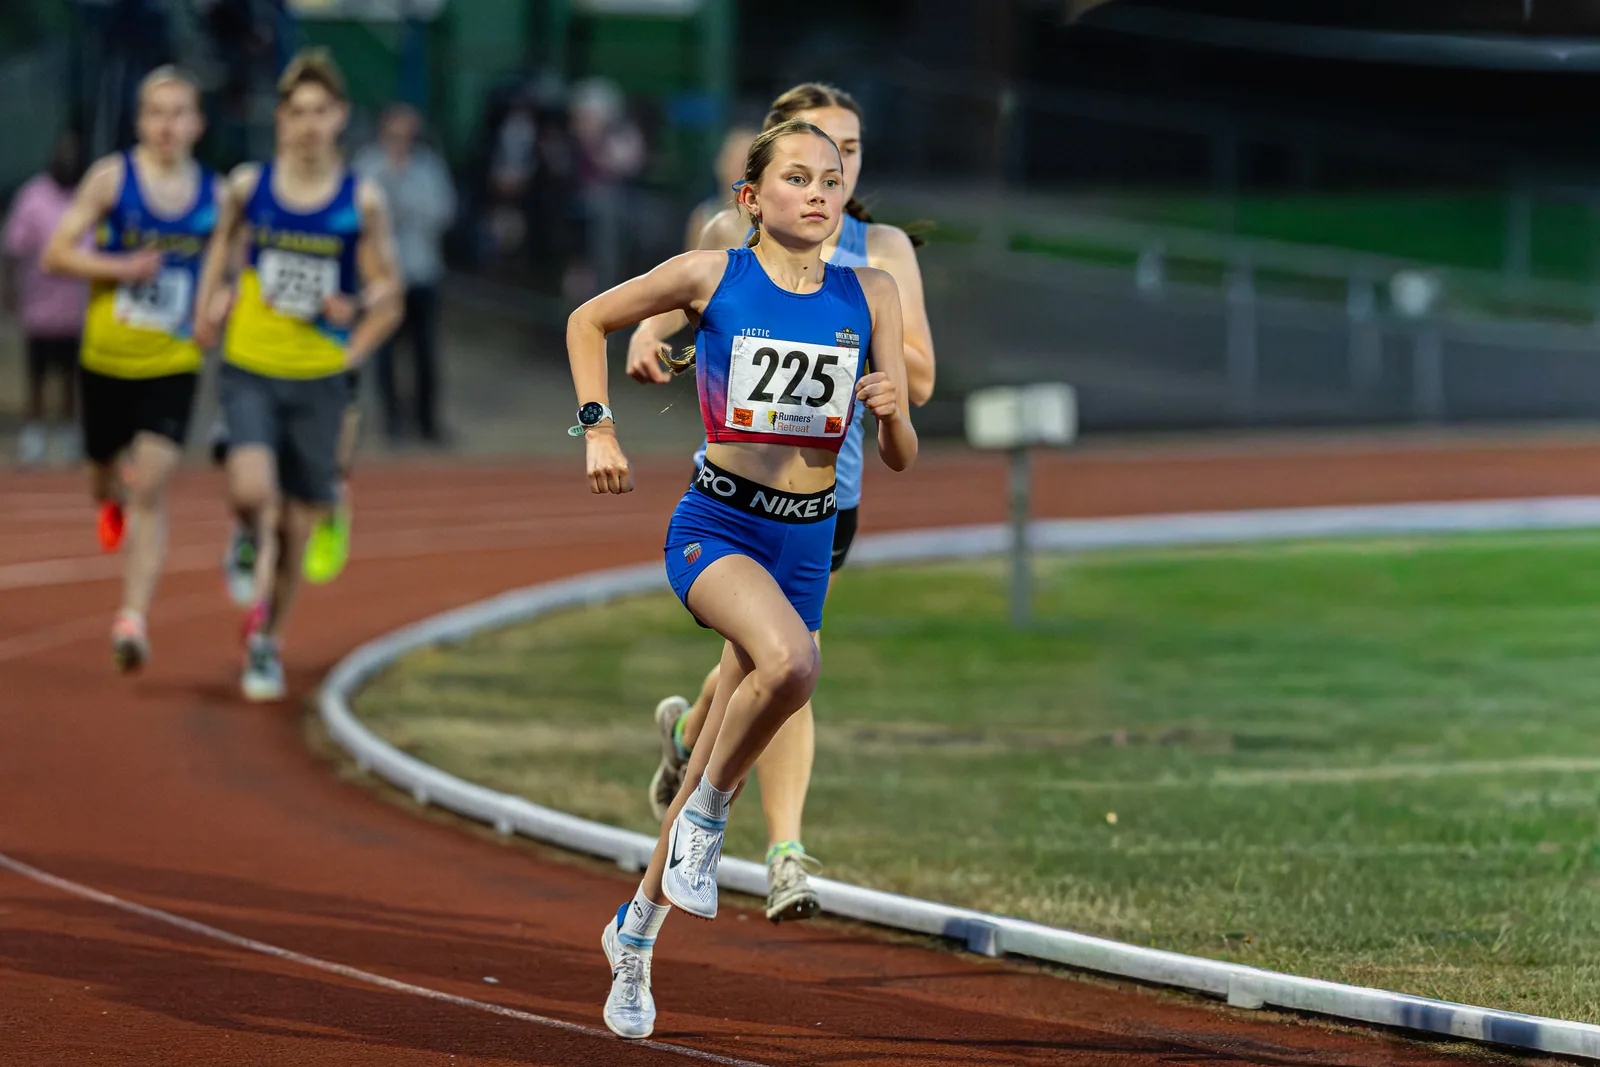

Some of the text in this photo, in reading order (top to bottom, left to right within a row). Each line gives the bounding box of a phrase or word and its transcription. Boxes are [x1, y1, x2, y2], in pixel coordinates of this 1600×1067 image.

[741, 328, 770, 337] TACTIC
[747, 347, 839, 407] 225
[778, 411, 814, 423] Runners'
[776, 422, 809, 433] Retreat
[698, 462, 737, 496] RO
[749, 490, 821, 518] NIKE
